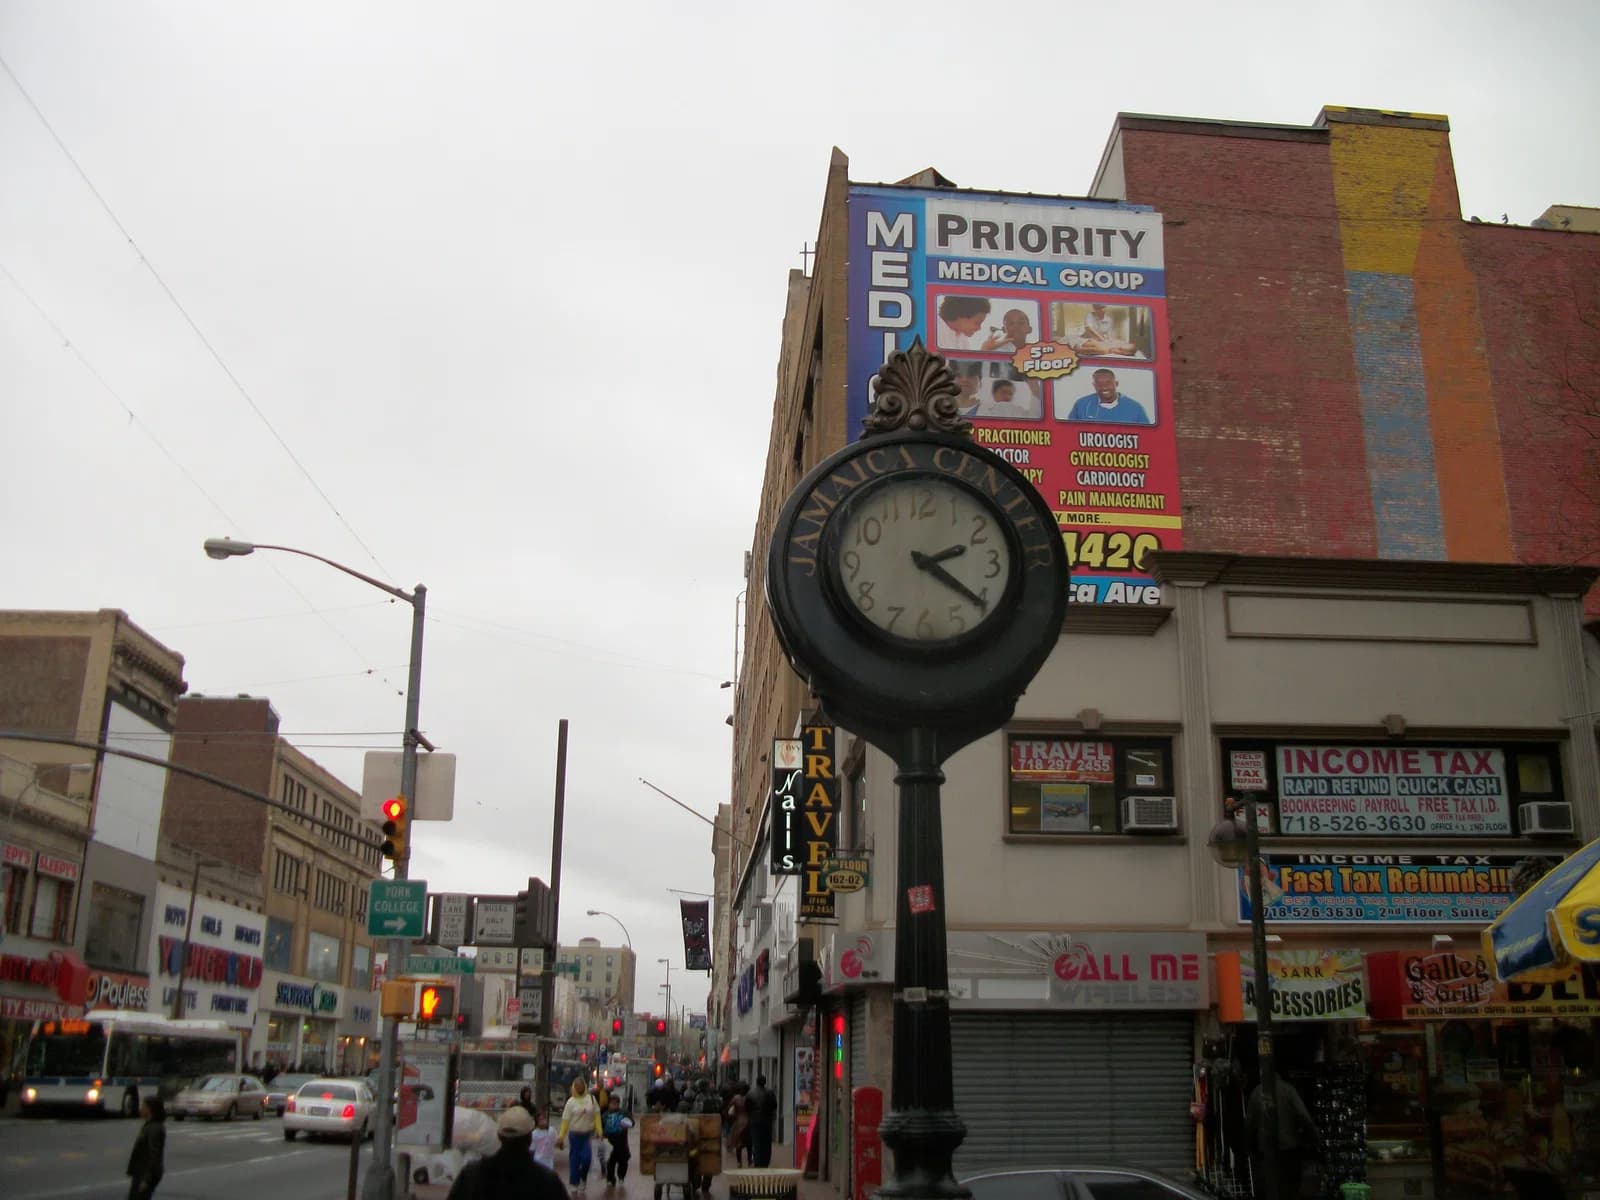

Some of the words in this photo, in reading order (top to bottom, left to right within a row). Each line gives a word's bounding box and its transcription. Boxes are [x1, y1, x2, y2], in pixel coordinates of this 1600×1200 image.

[936, 213, 1146, 260] PRIORITY
[938, 260, 1048, 286] MEDICAL
[1060, 268, 1144, 291] GROUP
[867, 211, 913, 404] MEDI
[1024, 358, 1072, 372] Floor
[978, 429, 1051, 446] PRACTITIONER
[1079, 432, 1139, 449] UROLOGIST
[1070, 451, 1150, 469] GYNECOLOGIST
[1076, 471, 1145, 488] CARDIOLOGY
[788, 444, 917, 577] JAMAICA
[932, 446, 1049, 570] CENTER
[911, 489, 936, 521] 12
[1059, 490, 1086, 506] PAIN
[1089, 492, 1165, 510] MANAGEMENT
[970, 515, 988, 545] 2
[844, 551, 861, 582] 9
[984, 550, 1001, 579] 3
[857, 581, 875, 611] 8
[1104, 582, 1160, 605] Ave
[887, 607, 905, 632] 7
[916, 608, 934, 639] 6
[1016, 741, 1112, 760] TRAVEL
[1019, 758, 1043, 769] 718
[1047, 759, 1073, 770] 297
[1077, 760, 1110, 771] 2455
[1284, 749, 1422, 774] INCOME
[1428, 751, 1495, 775] TAX
[1235, 769, 1260, 777] TAX
[1284, 778, 1328, 795] RAPID
[1332, 778, 1389, 794] REFUND
[1397, 778, 1449, 795] QUICK
[1454, 779, 1498, 794] CASH
[805, 727, 833, 896] TRAVEL
[1236, 808, 1268, 817] FX
[1281, 798, 1356, 813] BOOKKEEPING
[1364, 798, 1410, 813] PAYROLL
[1418, 799, 1449, 813] FREE
[1455, 799, 1477, 813] TAX
[775, 769, 803, 870] Nails
[1282, 815, 1426, 832] 718-526-3630
[1298, 855, 1413, 864] INCOME
[1436, 856, 1491, 865] TAX
[1280, 866, 1333, 893] Fast
[1338, 866, 1382, 893] Tax
[385, 886, 411, 896] YORK
[375, 900, 418, 913] COLLEGE
[1451, 908, 1489, 918] Suite
[1150, 954, 1199, 981] ME
[1281, 967, 1324, 978] SARR
[100, 976, 150, 1009] Payless
[1246, 978, 1362, 1016] ACESSORIES
[523, 1000, 540, 1008] WAY
